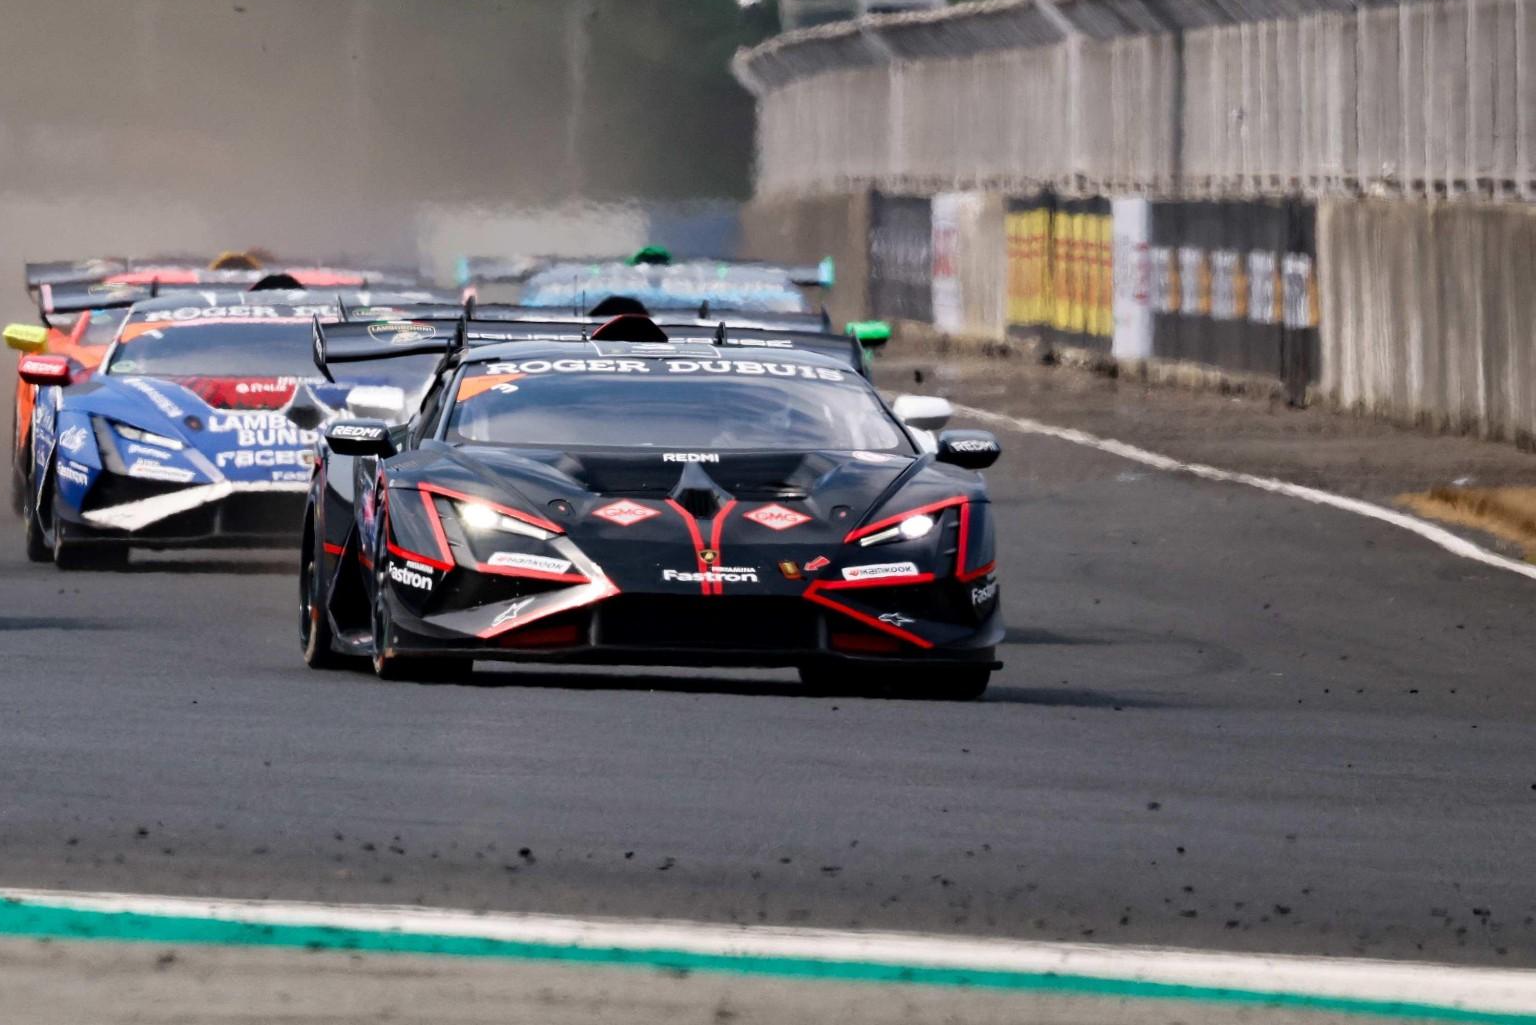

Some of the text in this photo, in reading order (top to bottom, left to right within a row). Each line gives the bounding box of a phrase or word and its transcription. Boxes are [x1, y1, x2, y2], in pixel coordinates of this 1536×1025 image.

[485, 359, 846, 382] ROGER DUBUIS
[331, 425, 383, 438] REDMI
[662, 452, 720, 463] REDMI
[603, 507, 648, 518] GMG
[753, 511, 799, 523] GMG
[662, 569, 759, 583] Fastron
